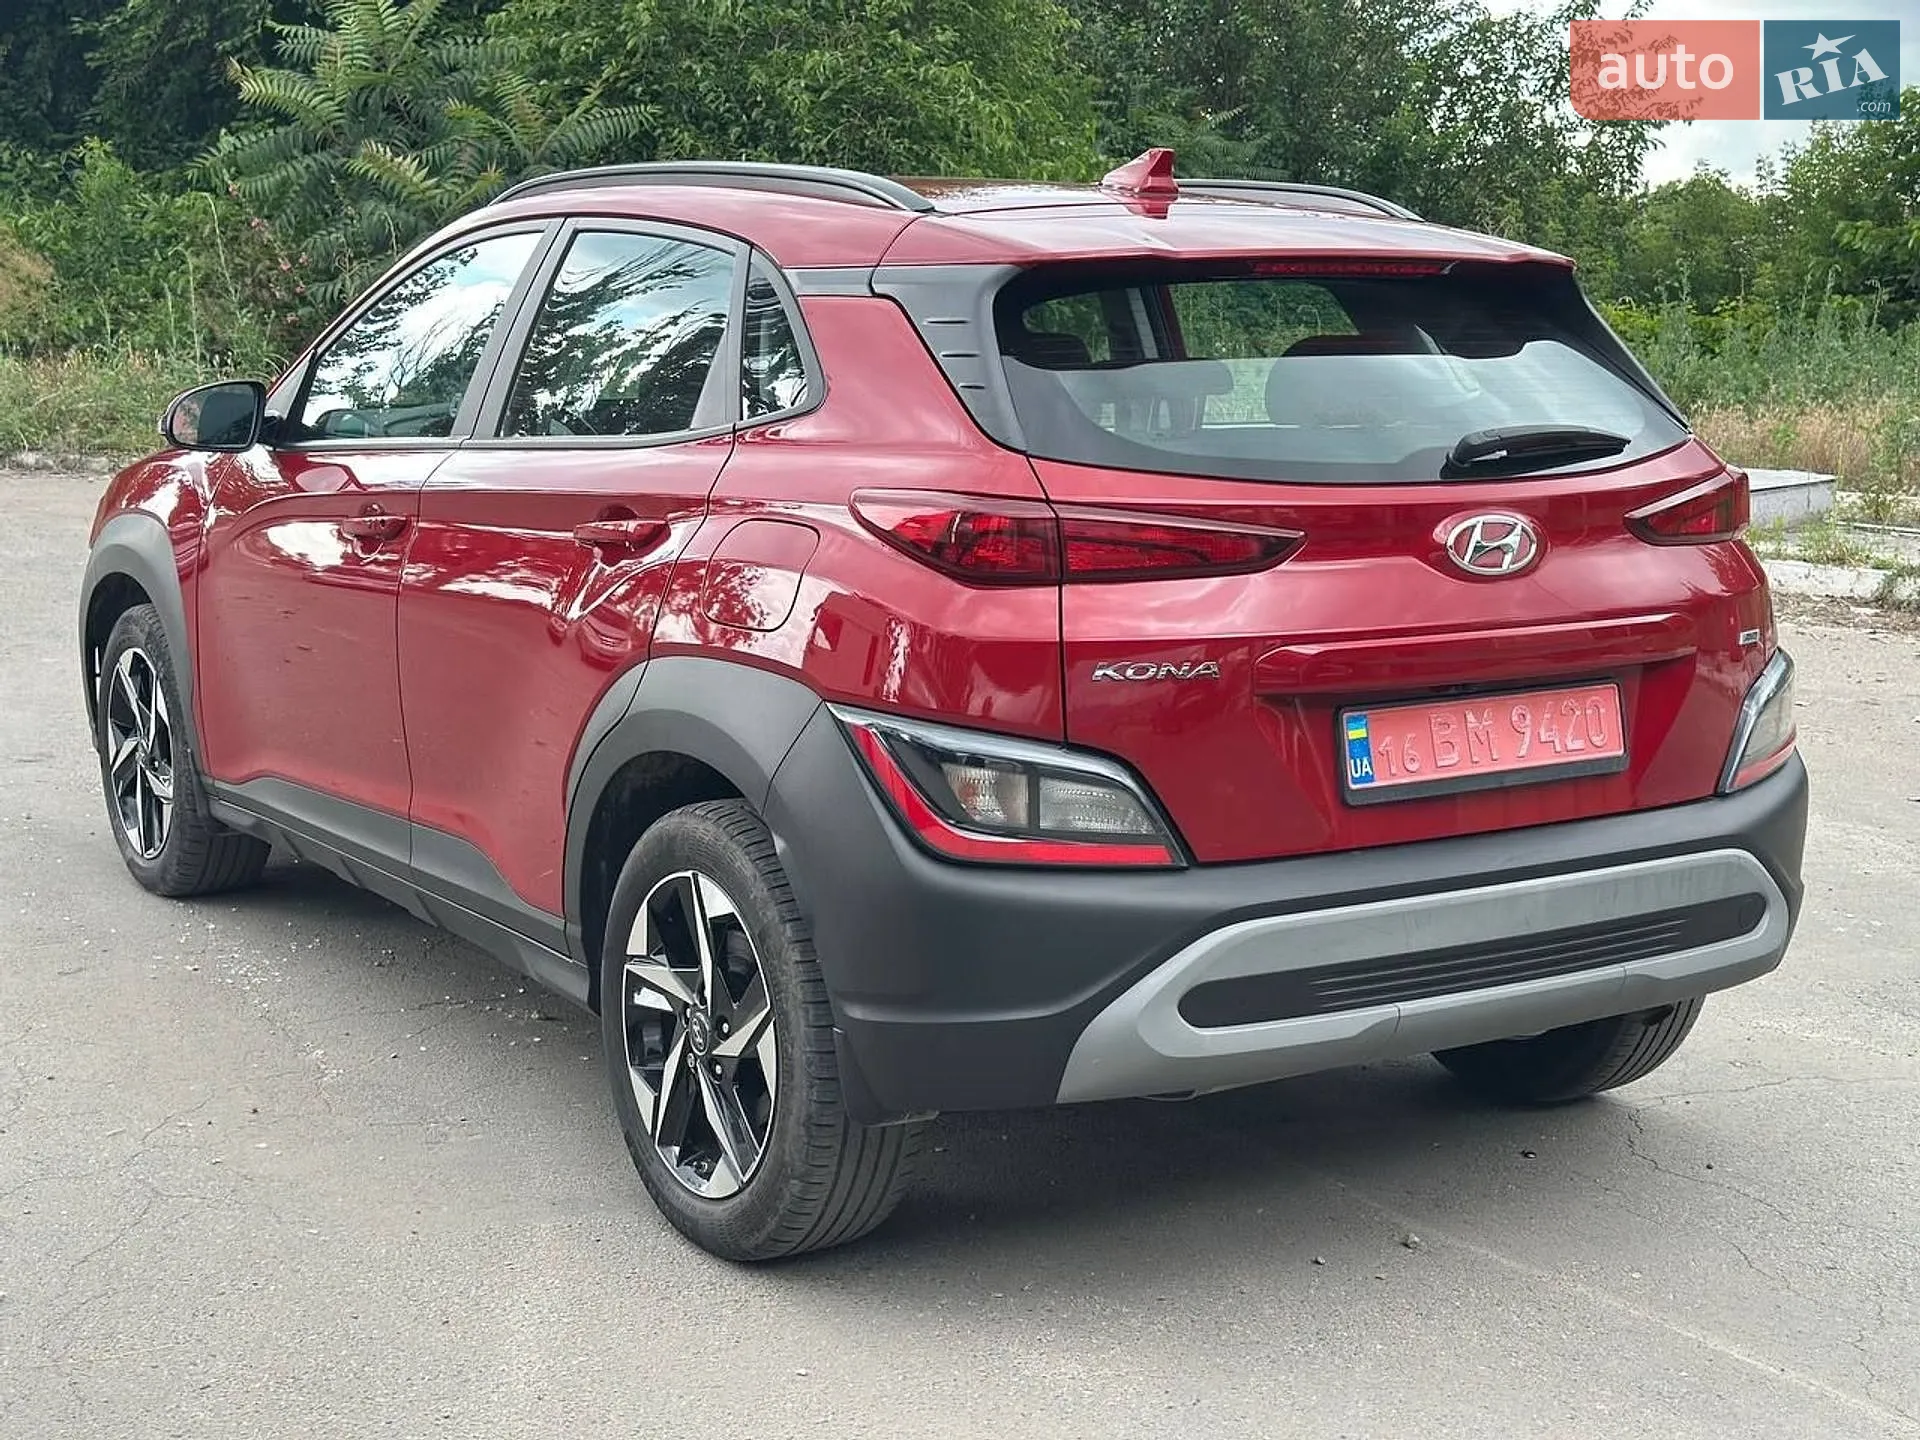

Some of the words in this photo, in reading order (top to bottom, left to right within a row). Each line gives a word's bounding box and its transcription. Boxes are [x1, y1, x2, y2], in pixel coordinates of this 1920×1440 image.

[1092, 661, 1221, 681] KONA
[1377, 732, 1420, 776] 16
[1428, 708, 1499, 768] BM
[1509, 695, 1608, 758] 9420
[1350, 756, 1373, 778] UA
